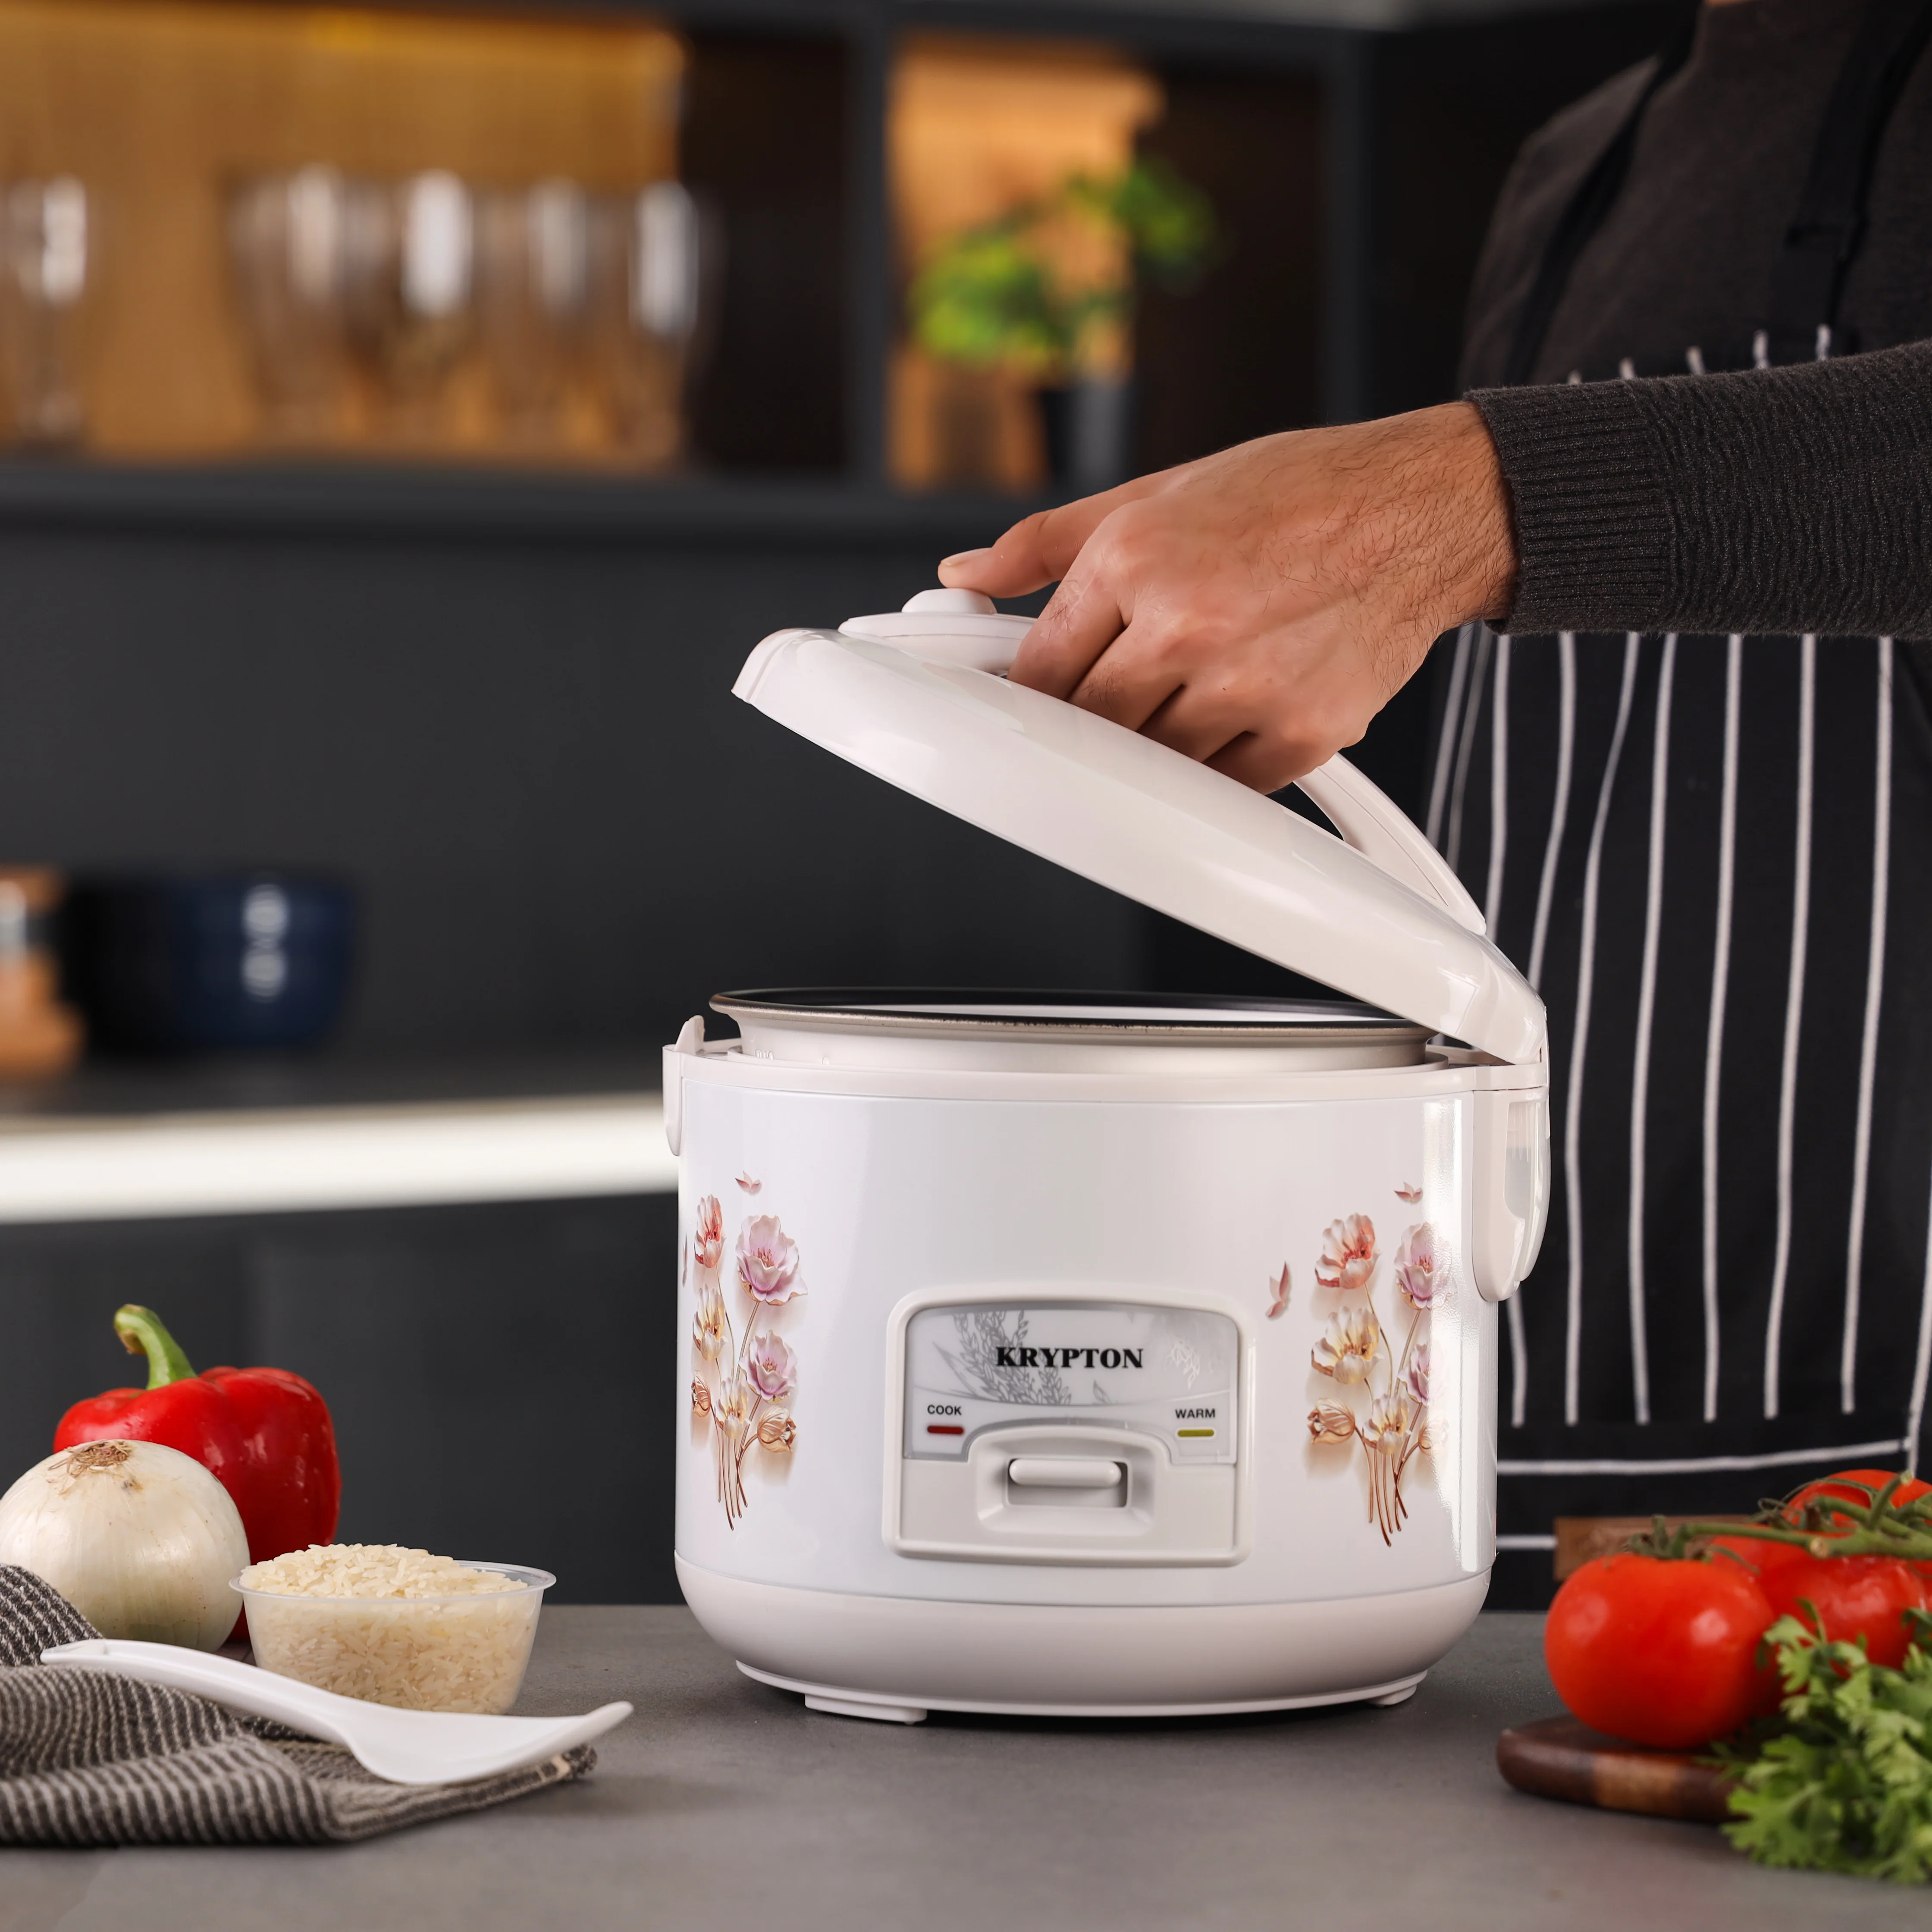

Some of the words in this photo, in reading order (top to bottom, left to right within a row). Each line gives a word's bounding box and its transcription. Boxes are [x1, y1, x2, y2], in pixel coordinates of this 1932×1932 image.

[995, 1347, 1143, 1368] KRYPTON
[927, 1405, 962, 1416] COOK
[1175, 1408, 1215, 1418] WARM
